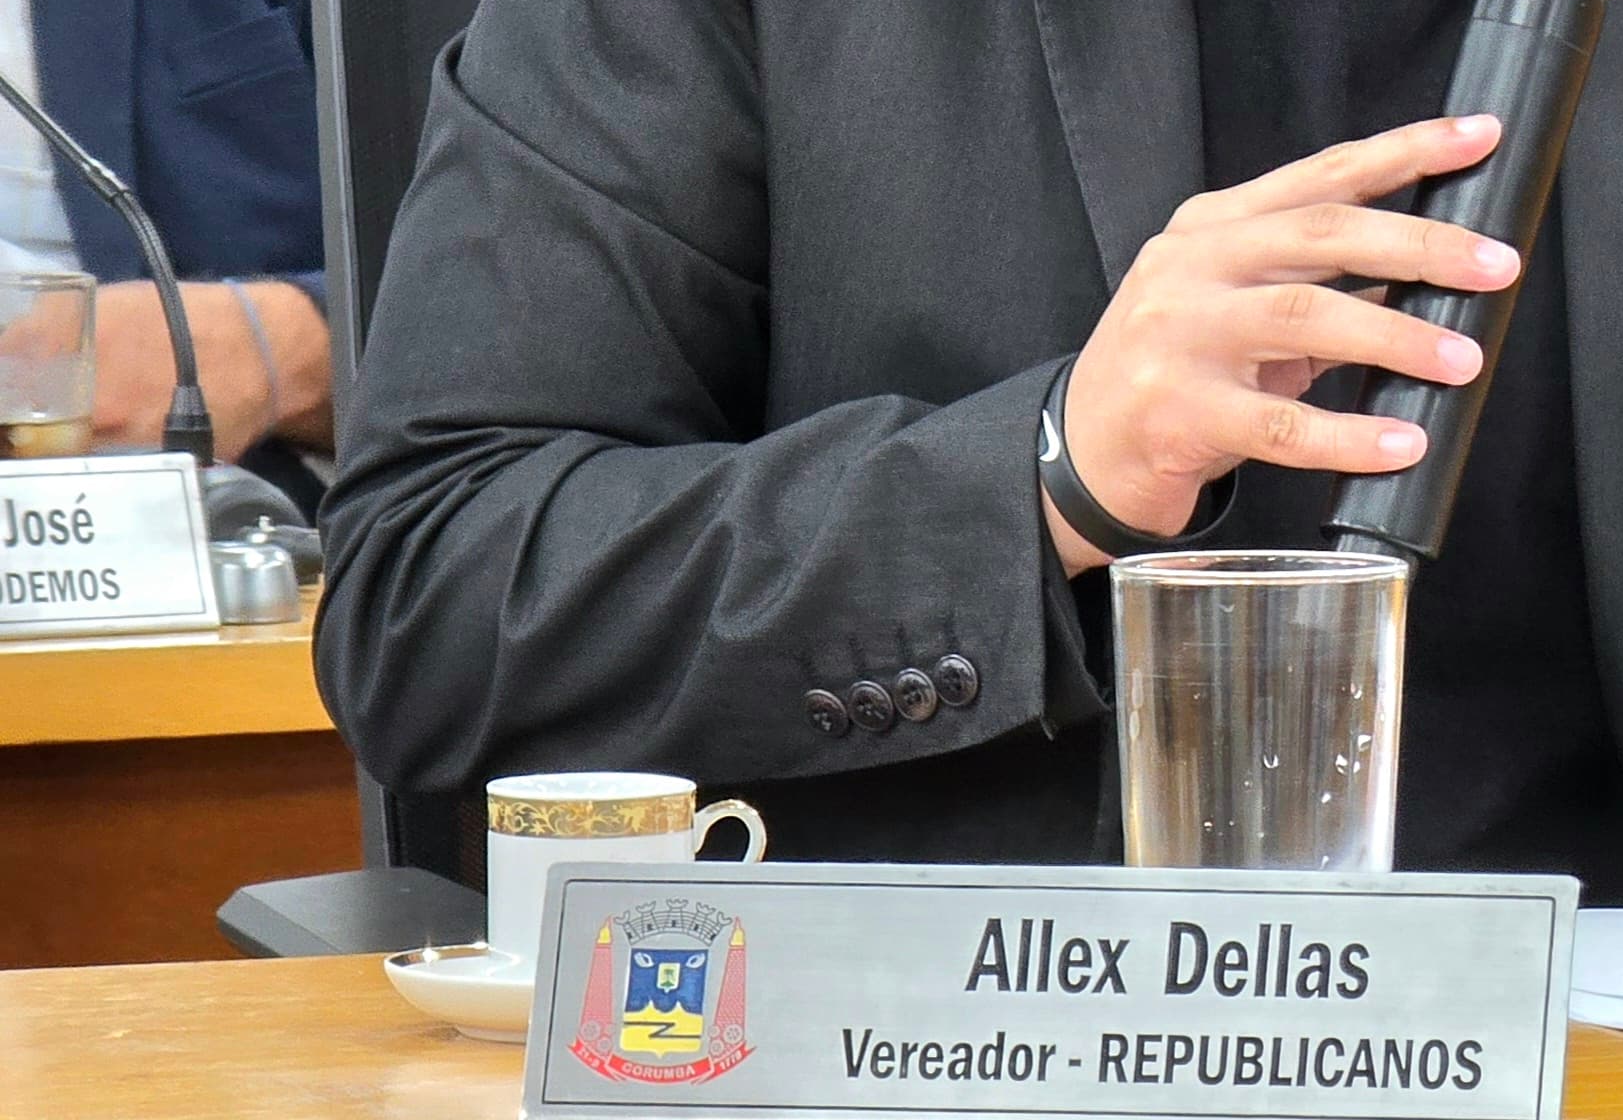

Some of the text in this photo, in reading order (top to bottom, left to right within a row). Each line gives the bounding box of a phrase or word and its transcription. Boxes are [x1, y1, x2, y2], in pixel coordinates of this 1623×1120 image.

[4, 492, 95, 547] José
[0, 568, 121, 604] DEMOS
[964, 917, 1371, 999] Allex Dellas
[842, 1028, 1057, 1082] Vereador
[1099, 1032, 1484, 1091] REPUBLICANOS
